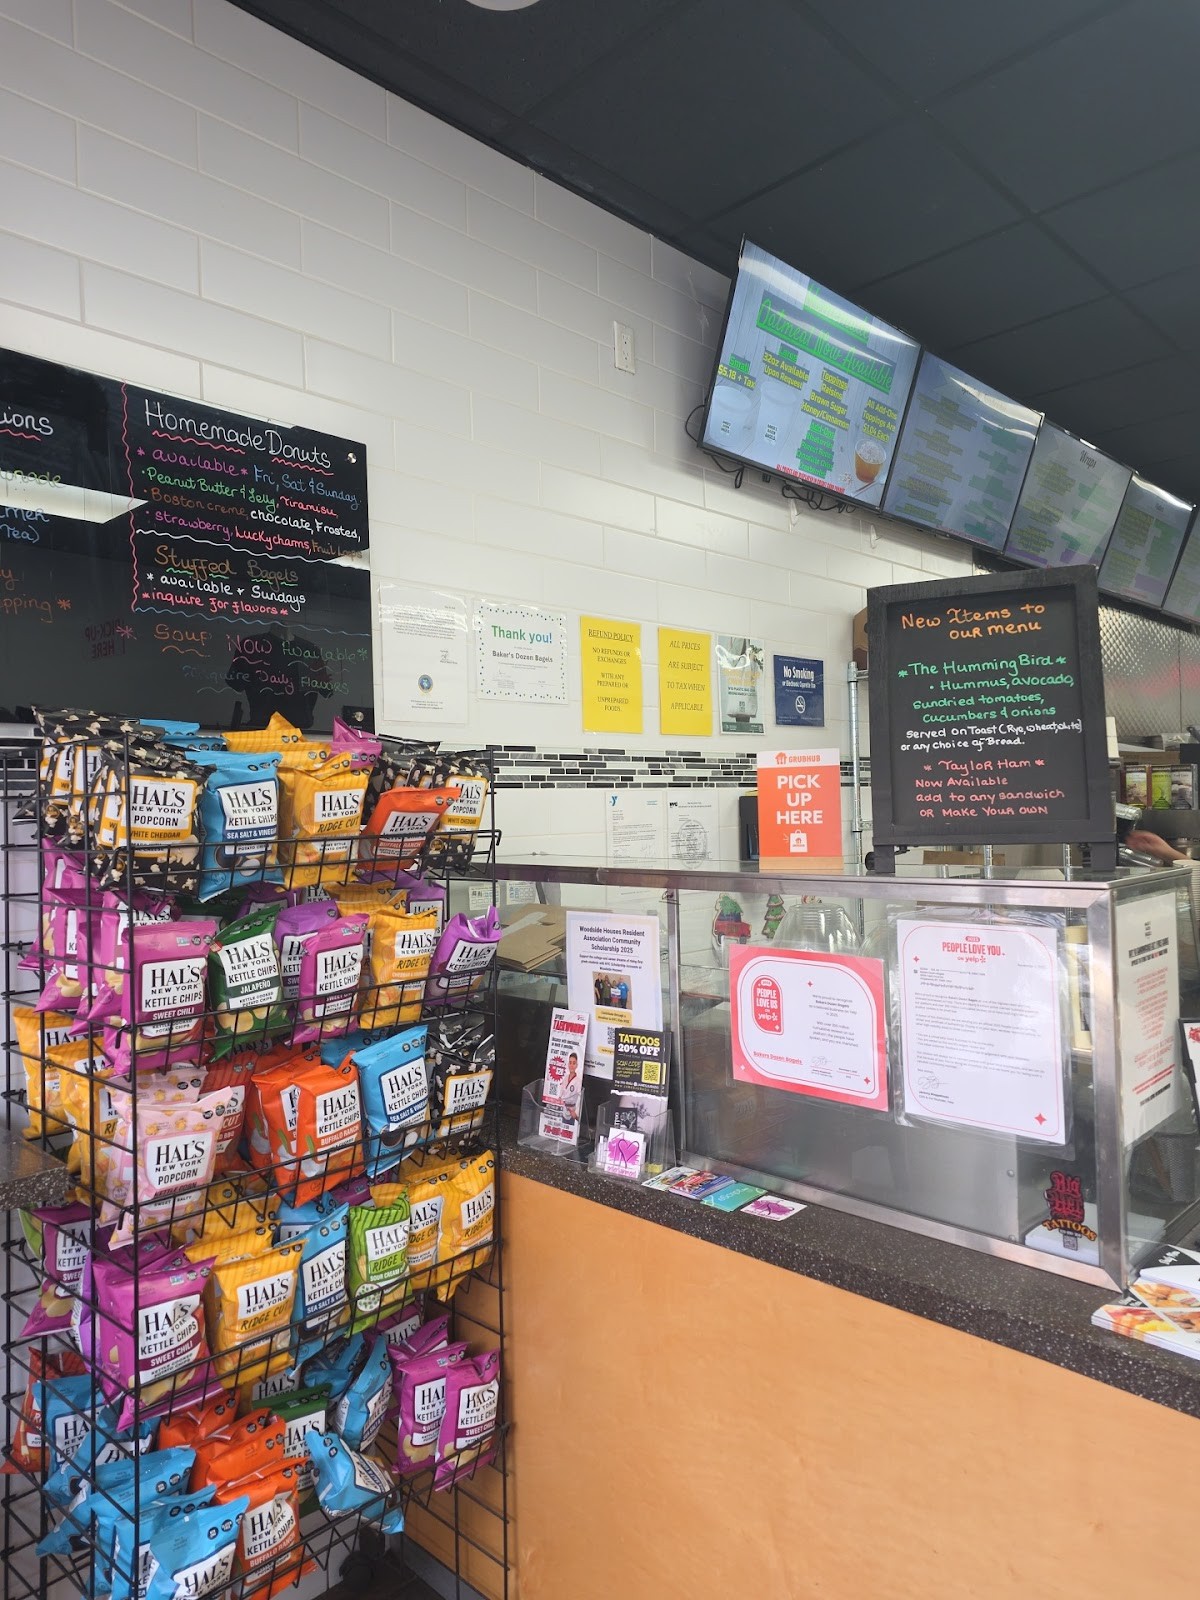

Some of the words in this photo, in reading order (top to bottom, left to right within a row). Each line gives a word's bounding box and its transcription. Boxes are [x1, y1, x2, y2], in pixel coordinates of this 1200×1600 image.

[729, 358, 750, 373] Small
[779, 360, 809, 380] Available
[810, 392, 829, 407] Brown
[830, 401, 847, 415] Sugar
[145, 399, 266, 450] Homemade
[264, 429, 332, 469] Donuts
[152, 449, 239, 477] available
[253, 465, 279, 491] Fri,
[282, 473, 306, 493] Sat
[147, 467, 196, 489] Peanut
[198, 478, 238, 498] Butter
[151, 488, 205, 510] Boston
[250, 510, 314, 535] chocolate,
[314, 518, 361, 542] Frosted,
[154, 544, 237, 581] Stuffed
[247, 559, 299, 592] Bagels
[160, 575, 233, 595] available
[251, 585, 307, 612] Sundays
[152, 588, 204, 606] inquire
[209, 597, 229, 613] for
[232, 602, 278, 616] flavors
[901, 613, 941, 629] New
[947, 608, 1012, 624] Items
[1020, 603, 1045, 615] to
[491, 624, 526, 641] Thank
[529, 632, 553, 645] you!
[588, 629, 613, 639] REFUND
[613, 632, 634, 642] POLICY
[987, 621, 1042, 635] menu
[601, 648, 623, 657] REFUNDS
[669, 640, 681, 649] ALL
[681, 641, 701, 651] PRICES
[492, 650, 514, 659] Baker's
[515, 653, 533, 661] Dozen
[535, 654, 553, 663] Bagels
[597, 656, 627, 664] EXCHANGES
[668, 660, 680, 669] ARE
[680, 662, 704, 672] SUBJECT
[908, 662, 938, 675] The
[943, 659, 1018, 677] Humming
[1018, 653, 1054, 666] Bird
[601, 672, 613, 680] WITH
[783, 665, 792, 678] No
[792, 666, 815, 682] Smoking
[597, 680, 621, 688] PREPARED
[667, 681, 675, 689] TO
[675, 682, 688, 690] TAX
[687, 683, 706, 691] WHEN
[940, 677, 1010, 691] Hummus,
[1011, 674, 1075, 688] avocado,
[597, 696, 629, 704] UNPREPARED
[978, 693, 1045, 704] tomatoes,
[671, 702, 704, 711] APPLICABLE
[1011, 705, 1056, 717] onions
[951, 727, 967, 735] on
[967, 725, 997, 736] Toast
[901, 743, 911, 751] or
[913, 743, 930, 752] any
[972, 738, 985, 751] of
[985, 737, 1025, 746] Bread.
[788, 754, 821, 763] GRUBHUB
[997, 759, 1031, 769] Ham
[777, 774, 820, 790] PICK
[915, 779, 942, 788] Now
[947, 776, 1008, 787] Available
[133, 785, 186, 808] HAL'S
[226, 788, 272, 808] HAL'S
[321, 793, 360, 812] HAL'S
[786, 793, 813, 807] UP
[916, 793, 942, 803] add
[949, 792, 965, 801] to
[970, 793, 996, 804] any
[999, 788, 1065, 800] sandwich
[158, 806, 184, 814] YORK
[776, 810, 823, 825] HERE
[919, 808, 934, 818] OR
[942, 807, 978, 817] Make
[1019, 806, 1048, 815] OWN
[133, 815, 179, 827] POPCORN
[318, 819, 344, 833] RIDGE
[345, 816, 360, 828] CUT
[393, 815, 431, 828] HAL'S
[579, 925, 603, 934] Woodside
[603, 927, 622, 935] Houses
[622, 929, 645, 937] Resident
[583, 934, 612, 943] Association
[612, 937, 641, 947] Community
[226, 940, 269, 964] HAL'S
[591, 943, 620, 953] Scholarship
[620, 946, 634, 954] 2025
[942, 941, 968, 954] PEOPLE
[968, 943, 986, 955] LOVE
[987, 945, 1001, 956] YOU
[324, 953, 358, 974] HAL'S
[151, 964, 200, 988] HAL'S
[151, 987, 173, 995] NEW
[176, 983, 199, 992] YORK
[756, 987, 777, 1000] PEOPLE
[144, 995, 178, 1009] KETTLE
[179, 991, 203, 1004] CHIPS
[756, 997, 770, 1008] LOVE
[770, 1000, 778, 1009] US
[152, 1010, 176, 1021] SWEET
[176, 1007, 195, 1018] CHILI
[757, 1012, 772, 1020] yelp
[618, 1033, 661, 1047] TATTOOS
[618, 1043, 638, 1054] 20%
[639, 1045, 661, 1056] OFF
[388, 1067, 423, 1094] HAL'S
[454, 1080, 486, 1098] HAL'S
[323, 1088, 357, 1116] HAL'S
[318, 1118, 342, 1135] KETTLE
[343, 1111, 360, 1126] CHIPS
[156, 1140, 205, 1166] HAL'S
[158, 1168, 198, 1185] POPCORN
[1042, 1219, 1097, 1241] TATTOOS
[245, 1278, 289, 1307] HAL'S
[307, 1284, 335, 1302] KETTLE
[144, 1303, 192, 1334] HAL'S
[140, 1337, 174, 1355] KETTLE
[176, 1320, 199, 1343] CHIPS
[150, 1350, 175, 1366] SWEET
[175, 1341, 194, 1360] CHILI
[460, 1414, 484, 1426] KETTLE
